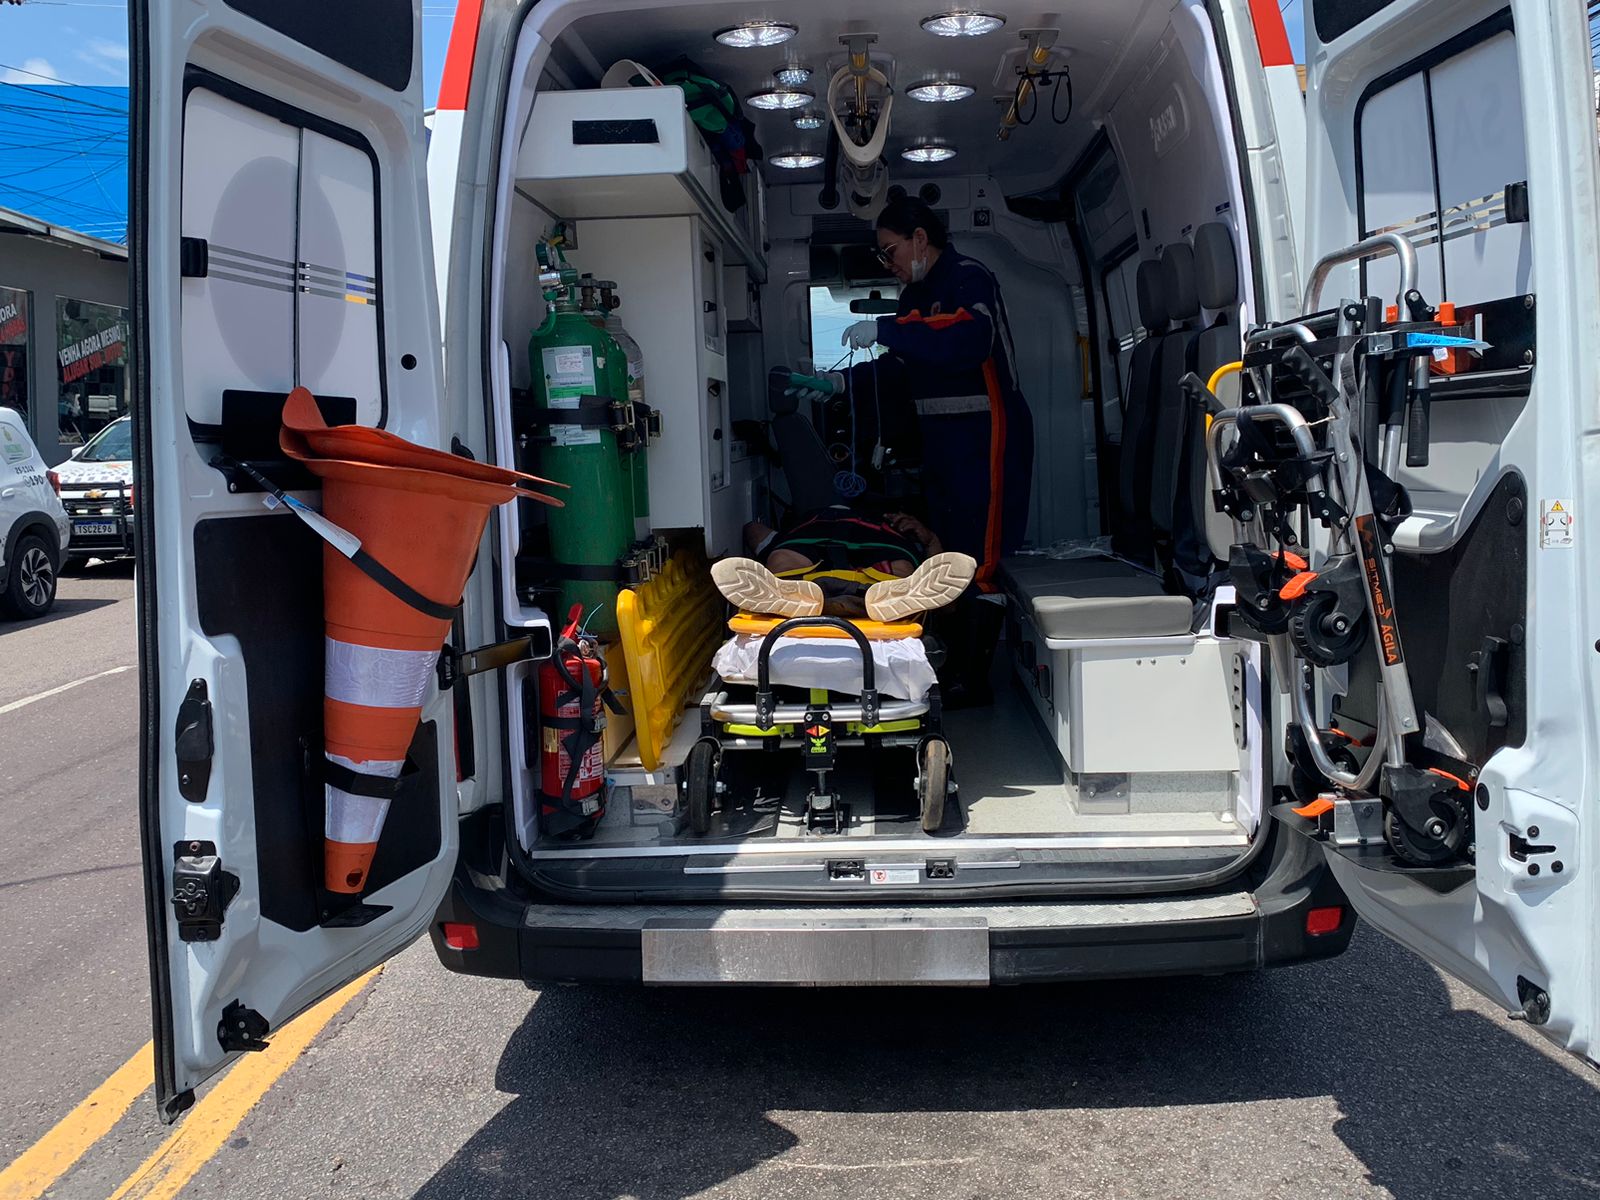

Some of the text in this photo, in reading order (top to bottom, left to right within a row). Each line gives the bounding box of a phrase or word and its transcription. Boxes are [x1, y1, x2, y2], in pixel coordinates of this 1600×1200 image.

[0, 303, 17, 323] ORA
[58, 343, 82, 367] VENHA
[81, 333, 102, 357] AGORA
[29, 474, 44, 486] 190
